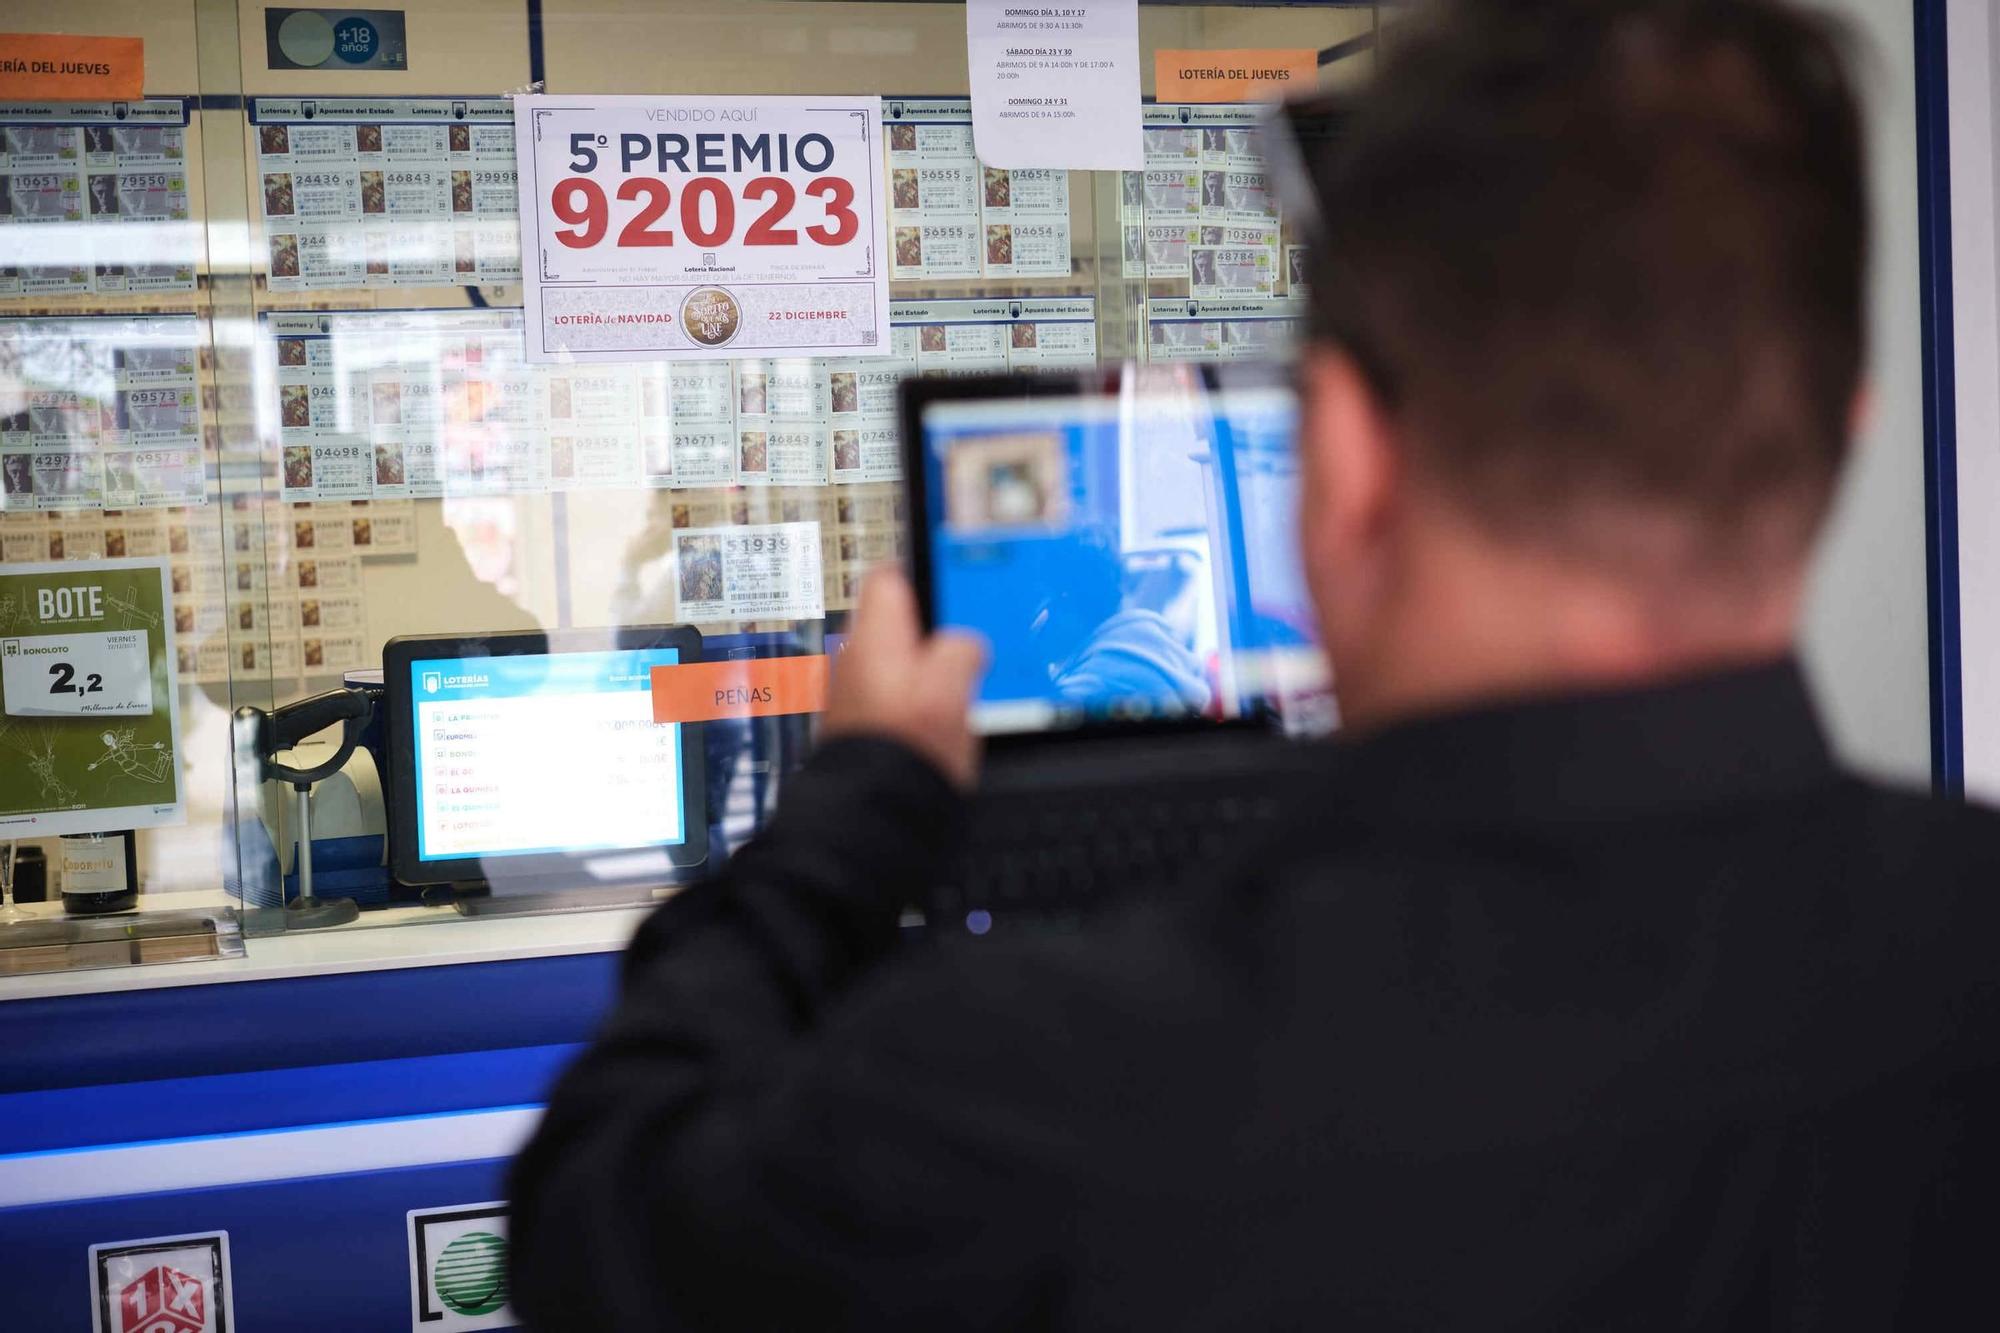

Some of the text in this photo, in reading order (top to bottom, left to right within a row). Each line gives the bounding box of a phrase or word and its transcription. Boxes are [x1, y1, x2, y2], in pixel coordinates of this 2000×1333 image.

[1041, 7, 1053, 16] DÍA
[339, 27, 370, 43] +18
[341, 42, 369, 52] años
[1006, 48, 1034, 56] SÁBADO
[31, 61, 55, 73] DEL
[59, 62, 110, 75] JUEVES
[996, 61, 1027, 69] ABRIMOS
[1028, 61, 1037, 69] DE
[1179, 66, 1290, 80] LOTERÍA DEL JUEVES
[131, 108, 166, 116] Apuestas
[319, 108, 354, 116] Apuestas
[469, 108, 502, 116] Apuestas
[645, 107, 758, 123] VENDIDO AQUÍ
[569, 132, 835, 174] 5º PREMIO
[296, 174, 341, 185] 24436
[387, 173, 431, 183] 46843
[475, 172, 518, 182] 29998
[922, 171, 960, 179] 56555
[1012, 170, 1051, 179] 04654
[1147, 173, 1183, 181] 60357
[15, 177, 59, 188] 10651
[121, 175, 166, 186] 79550
[1229, 175, 1264, 185] 10360
[551, 176, 859, 249] 92023
[924, 227, 963, 237] 56555
[1014, 227, 1053, 236] 04654
[1148, 229, 1184, 238] 60357
[1228, 230, 1262, 240] 10360
[1217, 253, 1254, 261] 48784
[708, 265, 736, 273] Nacional
[681, 274, 711, 282] SUERTE
[712, 274, 728, 282] QUE
[554, 311, 672, 325] LOTERÍA de NAVIDAD
[768, 310, 847, 321] 22 DICIEMBRE
[672, 376, 713, 388] 21671
[860, 373, 898, 384] 07494
[131, 391, 176, 402] 69573
[675, 435, 715, 447] 21671
[770, 435, 809, 446] 46843
[315, 447, 360, 458] 04698
[727, 538, 789, 552] 51939
[38, 585, 104, 620] BOTE
[107, 635, 137, 644] VIERNES
[23, 646, 69, 656] BONOLOTO
[49, 662, 103, 698] 2,2
[444, 674, 488, 684] LOTERÍAS
[715, 686, 772, 706] PEÑAS
